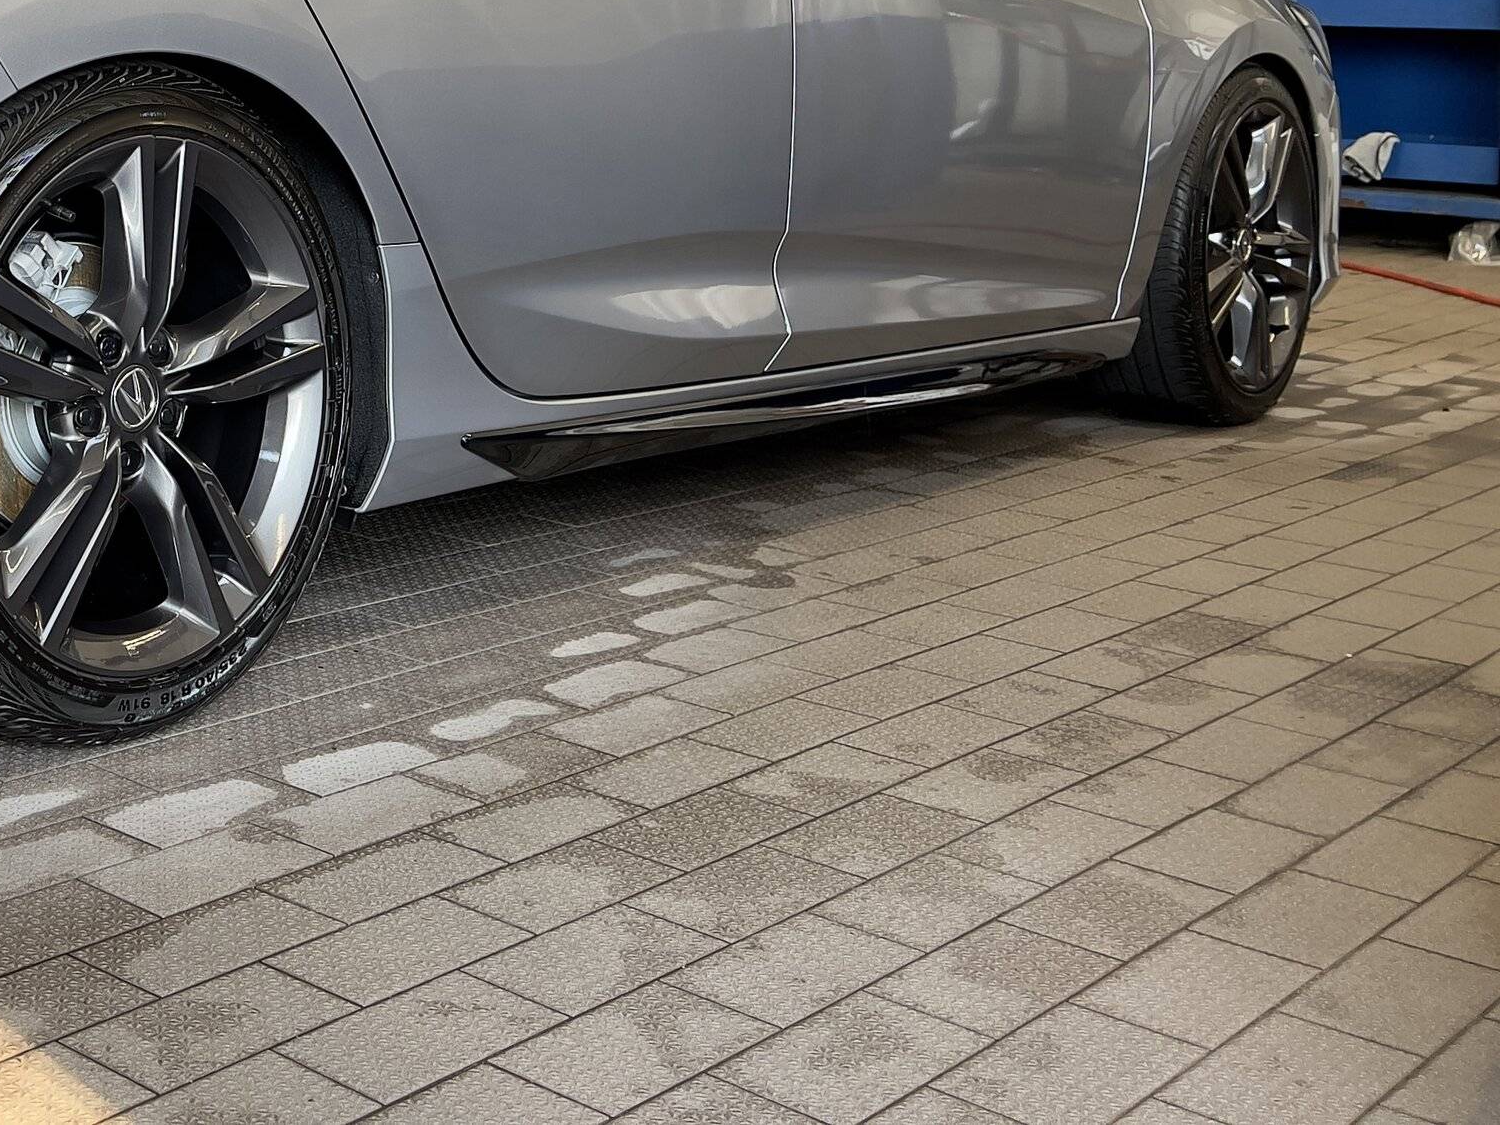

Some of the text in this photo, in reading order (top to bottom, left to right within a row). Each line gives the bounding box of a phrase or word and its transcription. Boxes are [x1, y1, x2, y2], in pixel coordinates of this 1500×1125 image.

[117, 643, 248, 712] 235/40 R 18 91W
